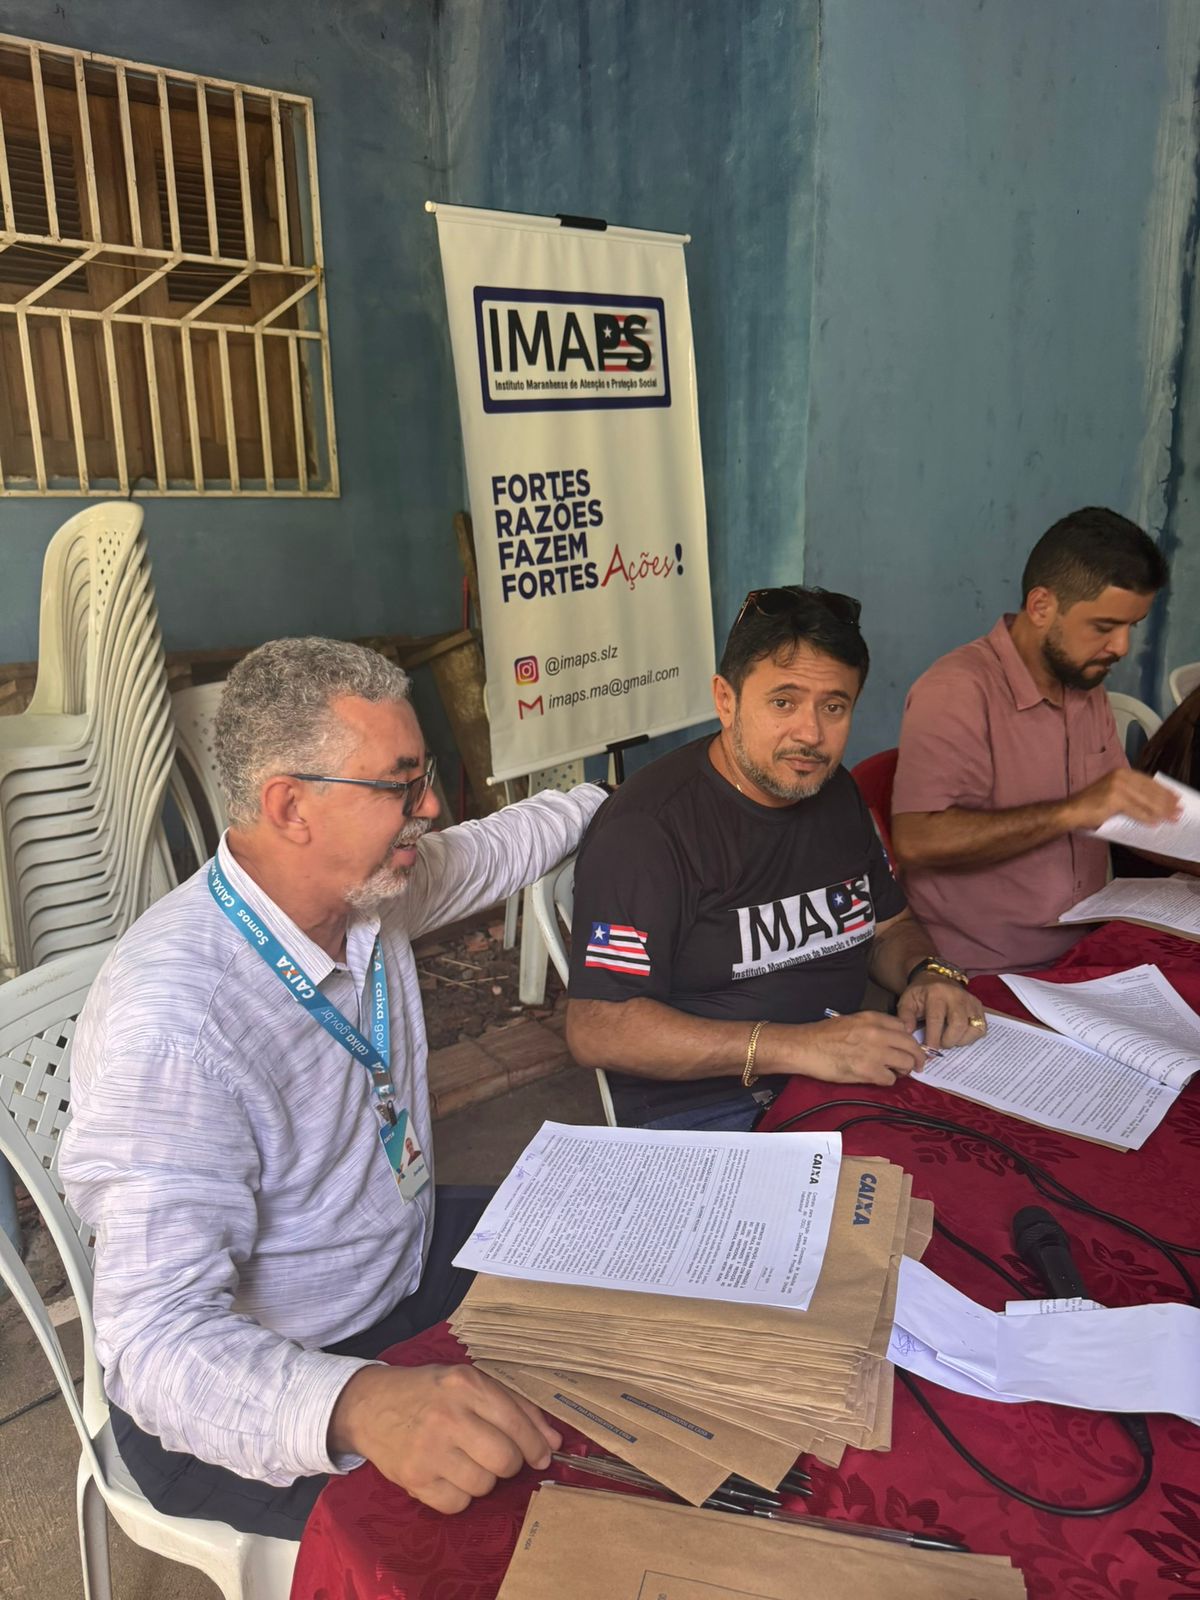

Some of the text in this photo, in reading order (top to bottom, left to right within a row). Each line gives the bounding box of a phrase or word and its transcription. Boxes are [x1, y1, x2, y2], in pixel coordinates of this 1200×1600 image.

[489, 308, 651, 372] IMAPS
[495, 378, 657, 391] Instituto Maranhense de Atenção e Proteção Social
[492, 469, 590, 505] FORTES
[495, 495, 604, 538] RAZÕES
[498, 532, 588, 570] FAZEM
[502, 562, 599, 603] FORTES
[545, 645, 618, 676] @imaps.slz
[549, 667, 679, 709] imaps.ma@gmail.com
[237, 909, 269, 946] Somos
[729, 874, 875, 965] IMAPS
[732, 967, 766, 979] Instituto
[767, 953, 811, 973] Maranhense
[812, 949, 821, 958] de
[821, 941, 845, 955] Atenção
[276, 955, 369, 1056] caixa.gov.br CAIXA
[809, 1153, 823, 1185] CAIXA
[853, 1173, 877, 1225] CAIXA
